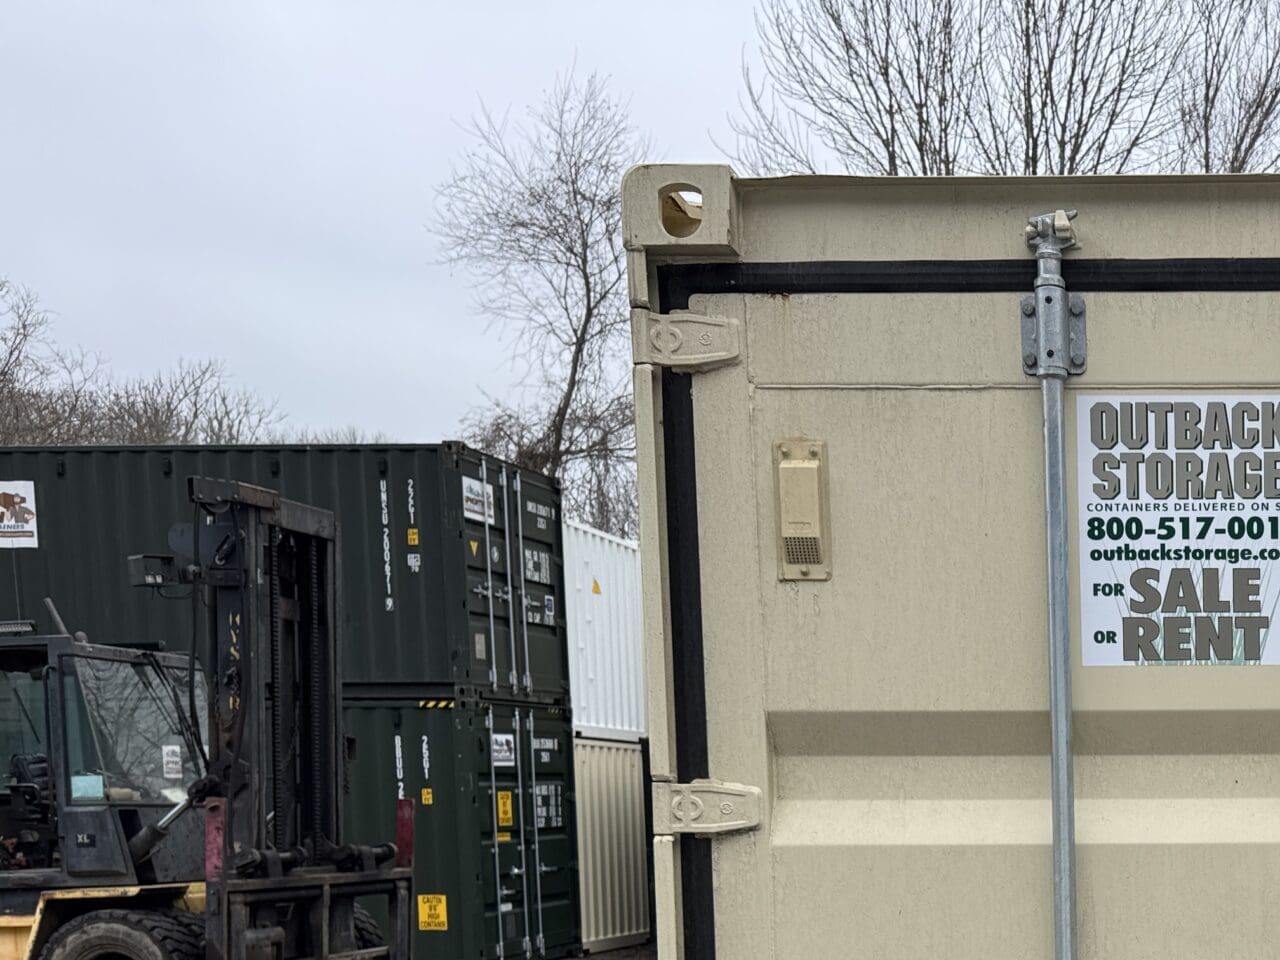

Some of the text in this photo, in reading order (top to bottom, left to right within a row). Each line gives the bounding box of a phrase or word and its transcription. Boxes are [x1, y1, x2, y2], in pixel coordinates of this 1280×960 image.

[1087, 503, 1170, 513] CONTAINERS
[1175, 503, 1247, 513] DELIVERED
[1251, 503, 1270, 513] ON
[1093, 568, 1263, 615] FOR SALE
[1094, 616, 1271, 663] OR RENT
[76, 833, 91, 844] XL
